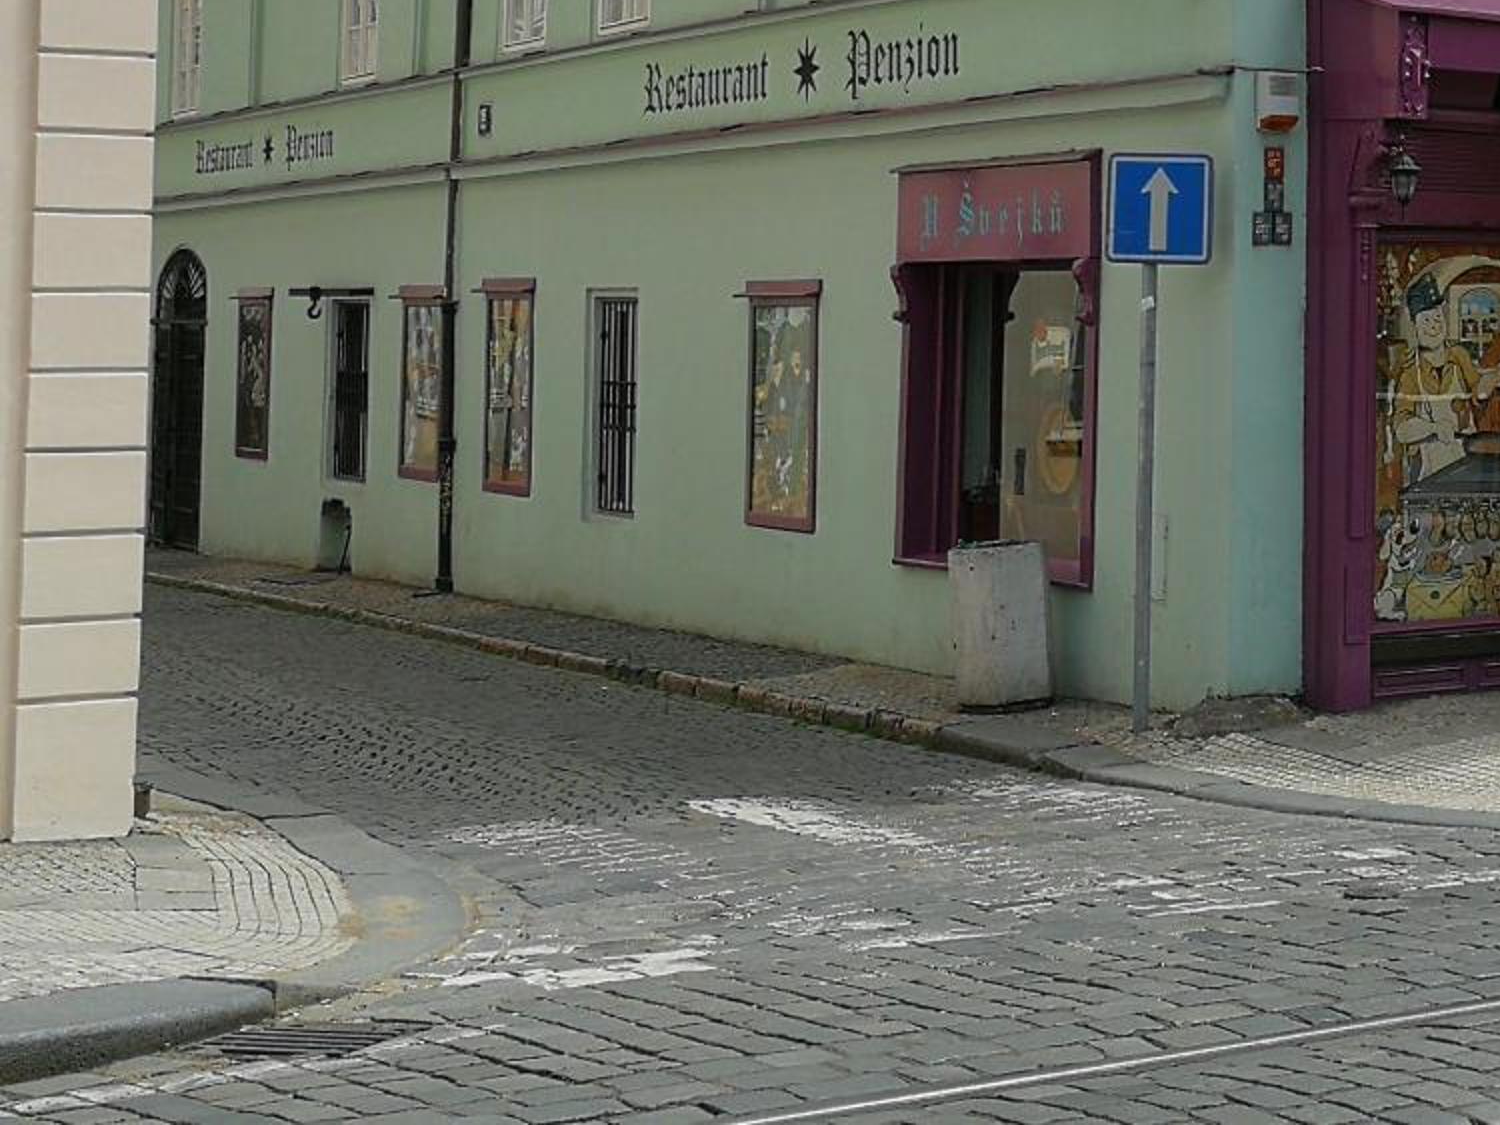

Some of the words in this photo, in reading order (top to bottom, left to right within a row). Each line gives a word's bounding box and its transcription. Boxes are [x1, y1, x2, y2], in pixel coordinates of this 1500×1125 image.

[643, 52, 768, 115] Restaurant
[845, 23, 960, 100] Penzion
[196, 139, 253, 174] Restaurant
[287, 125, 334, 171] Penzion
